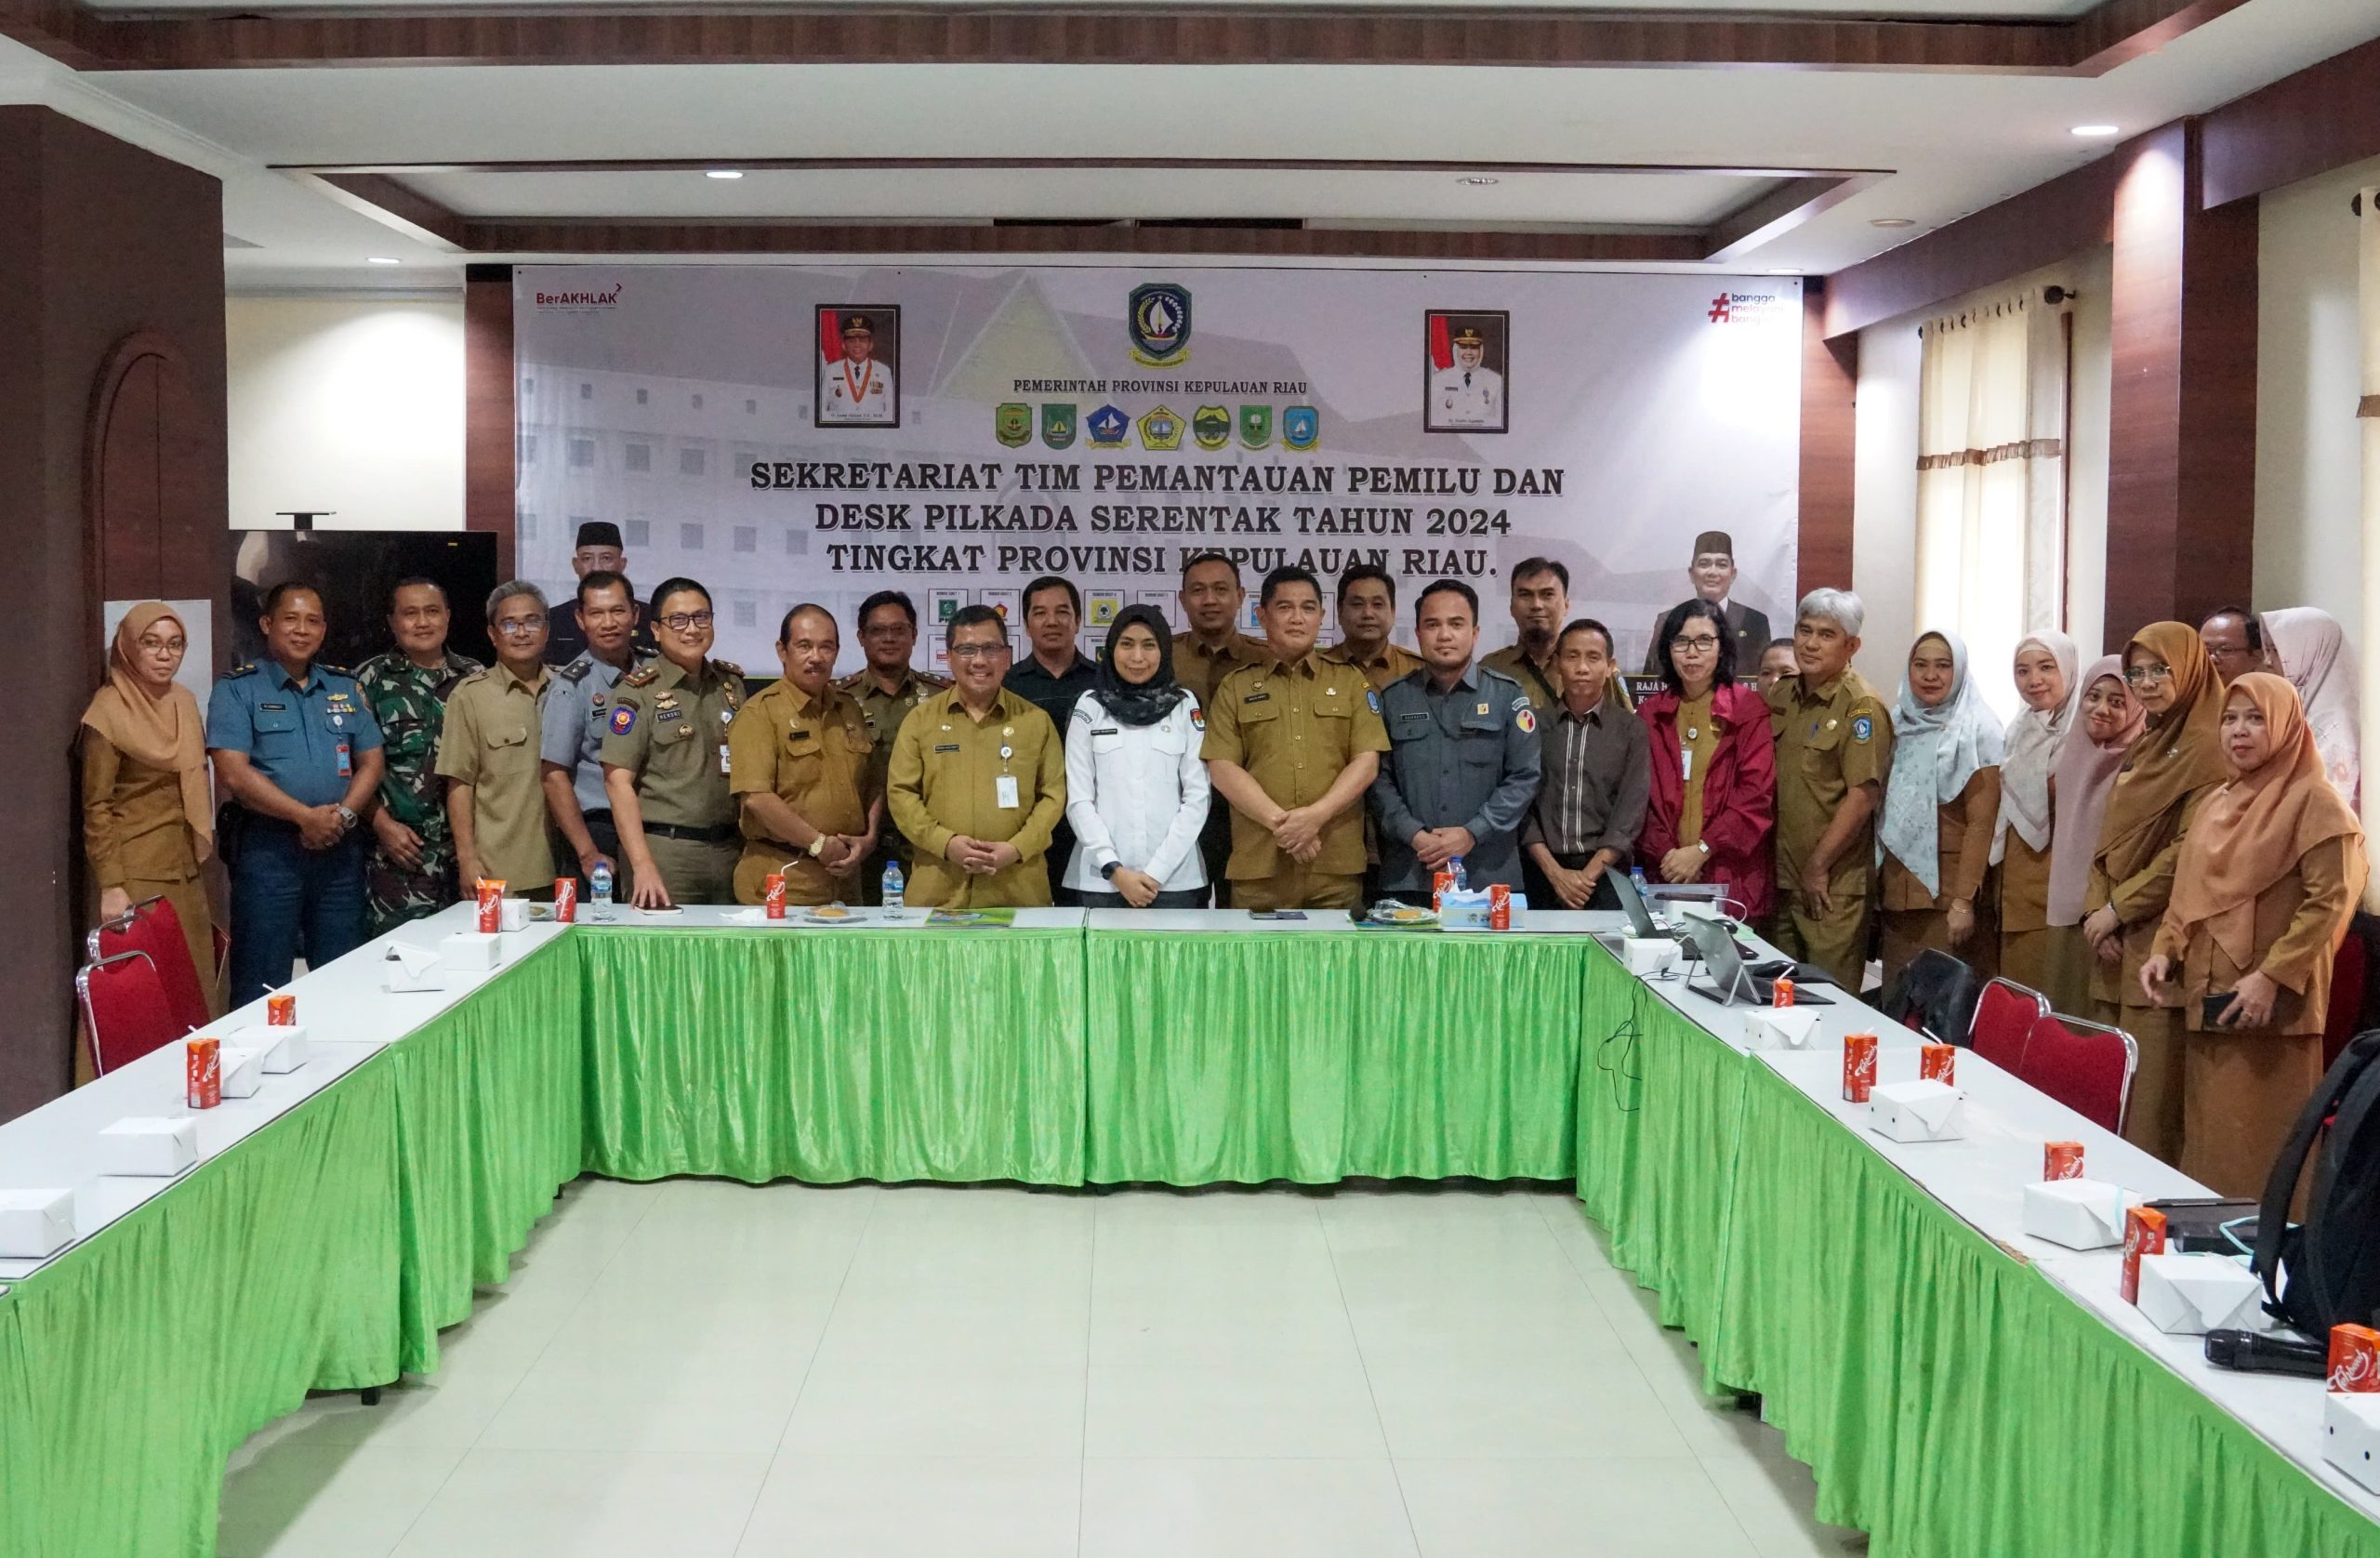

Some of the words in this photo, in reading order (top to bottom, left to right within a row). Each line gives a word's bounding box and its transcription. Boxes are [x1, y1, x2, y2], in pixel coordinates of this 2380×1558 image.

[536, 292, 617, 304] BerAKHLAK
[1731, 293, 1775, 305] bangga
[1013, 379, 1107, 392] PEMERINTAH
[1112, 380, 1179, 393] PROVINSI
[1184, 381, 1268, 393] KEPULAUAN
[1274, 382, 1307, 394] RIAU
[750, 462, 1004, 492] SEKRETARIAT
[1014, 463, 1080, 493] TIM
[1093, 464, 1335, 495] PEMANTAUAN
[1347, 467, 1480, 496] PEMILU
[1493, 468, 1565, 496] DAN
[814, 503, 912, 533] DESK
[923, 504, 1079, 534] PILKADA
[1091, 505, 1281, 535] SERENTAK
[1292, 507, 1414, 536] TAHUN
[1426, 508, 1512, 537] 2024
[826, 544, 986, 574] TINGKAT
[997, 546, 1166, 575] PROVINSI
[1179, 547, 1390, 575] KPULAUAN
[1402, 548, 1497, 577] RIAU.
[1636, 681, 1659, 691] RAJA
